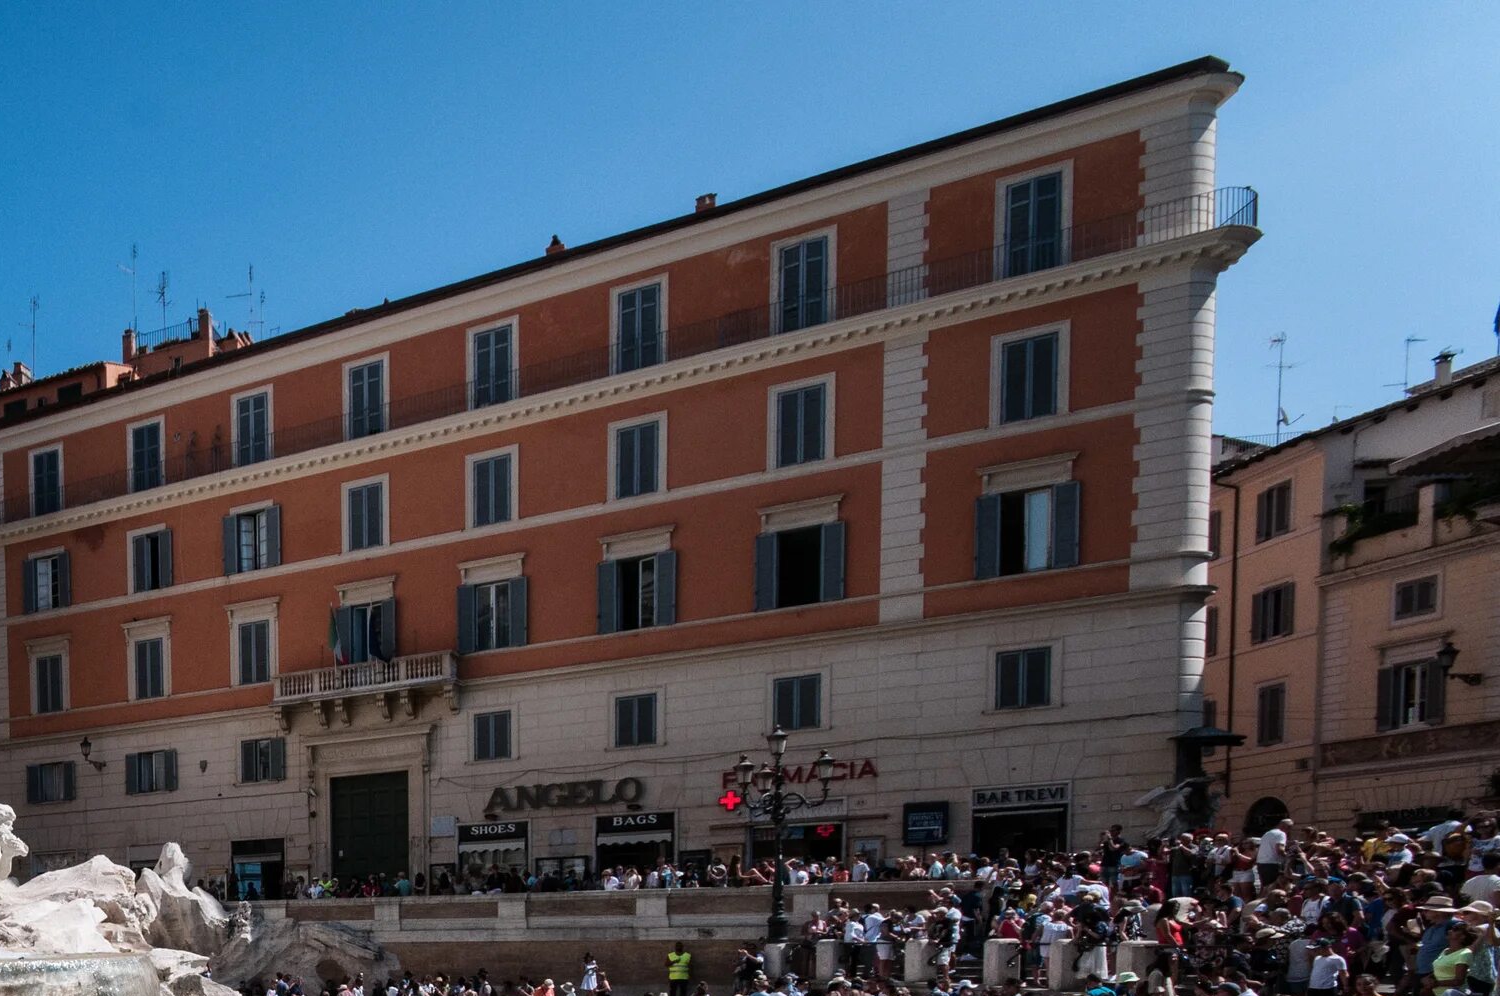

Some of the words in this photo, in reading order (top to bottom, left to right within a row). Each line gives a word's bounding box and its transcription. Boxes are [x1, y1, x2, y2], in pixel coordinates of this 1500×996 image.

[722, 759, 878, 789] FMACIA
[483, 776, 646, 813] ANGELO
[977, 791, 1010, 805] BAR
[1015, 787, 1064, 802] TREVI
[470, 823, 516, 836] SHOES
[612, 814, 658, 827] BAGS
